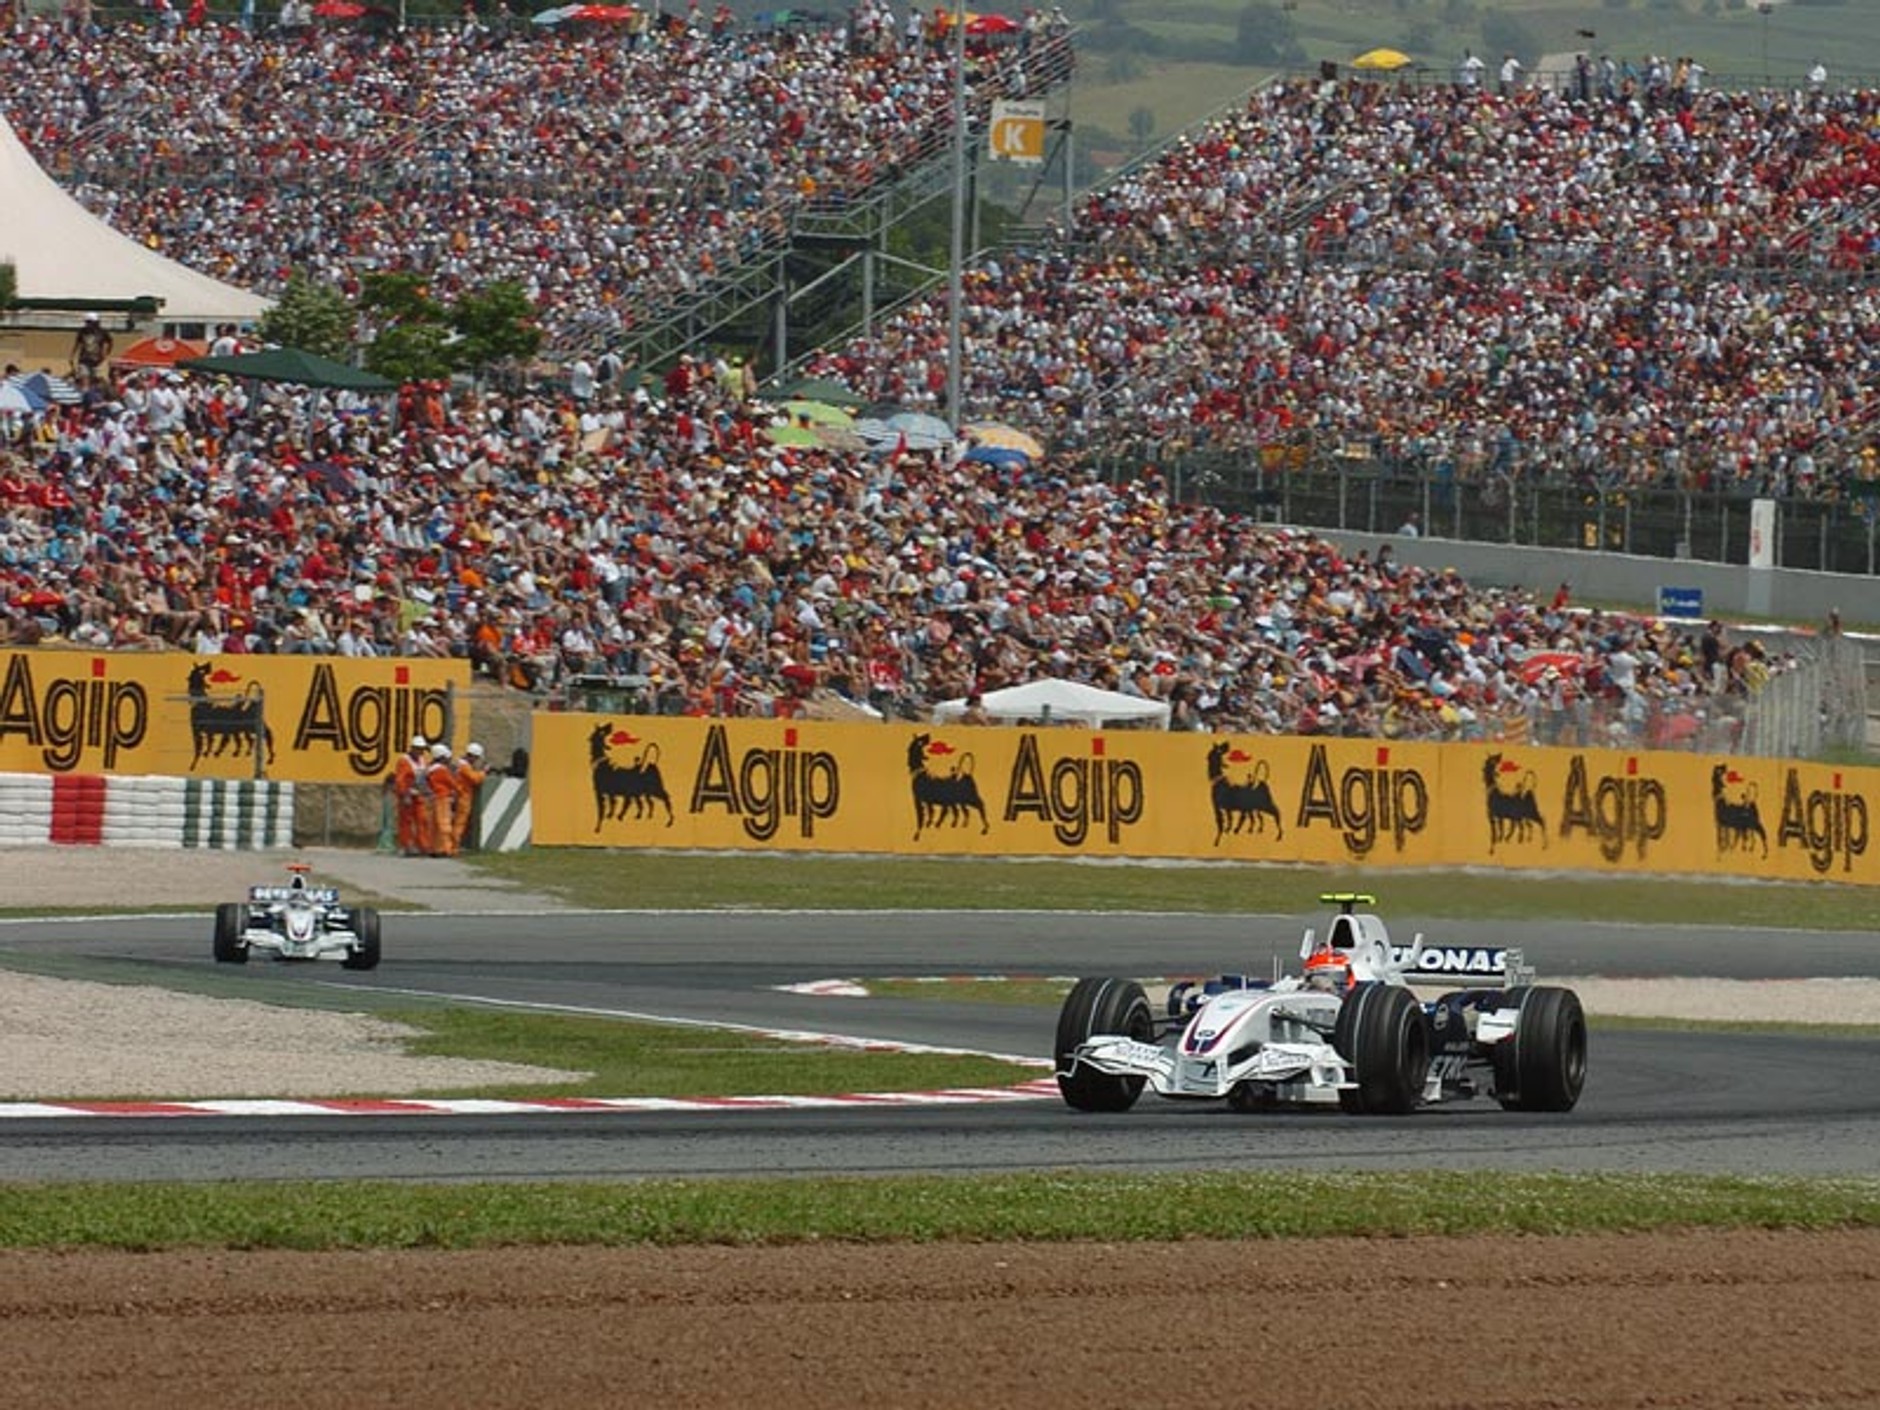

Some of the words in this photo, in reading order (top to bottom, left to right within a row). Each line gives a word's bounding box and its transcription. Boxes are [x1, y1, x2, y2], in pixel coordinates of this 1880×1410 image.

[1004, 122, 1026, 152] K
[0, 655, 148, 772] Agip
[294, 663, 450, 777] Agip
[689, 726, 840, 842] Agip
[1004, 735, 1144, 847] Agip
[1297, 744, 1429, 861] Agip
[1560, 754, 1667, 863] Agip
[1777, 766, 1870, 874] Agip
